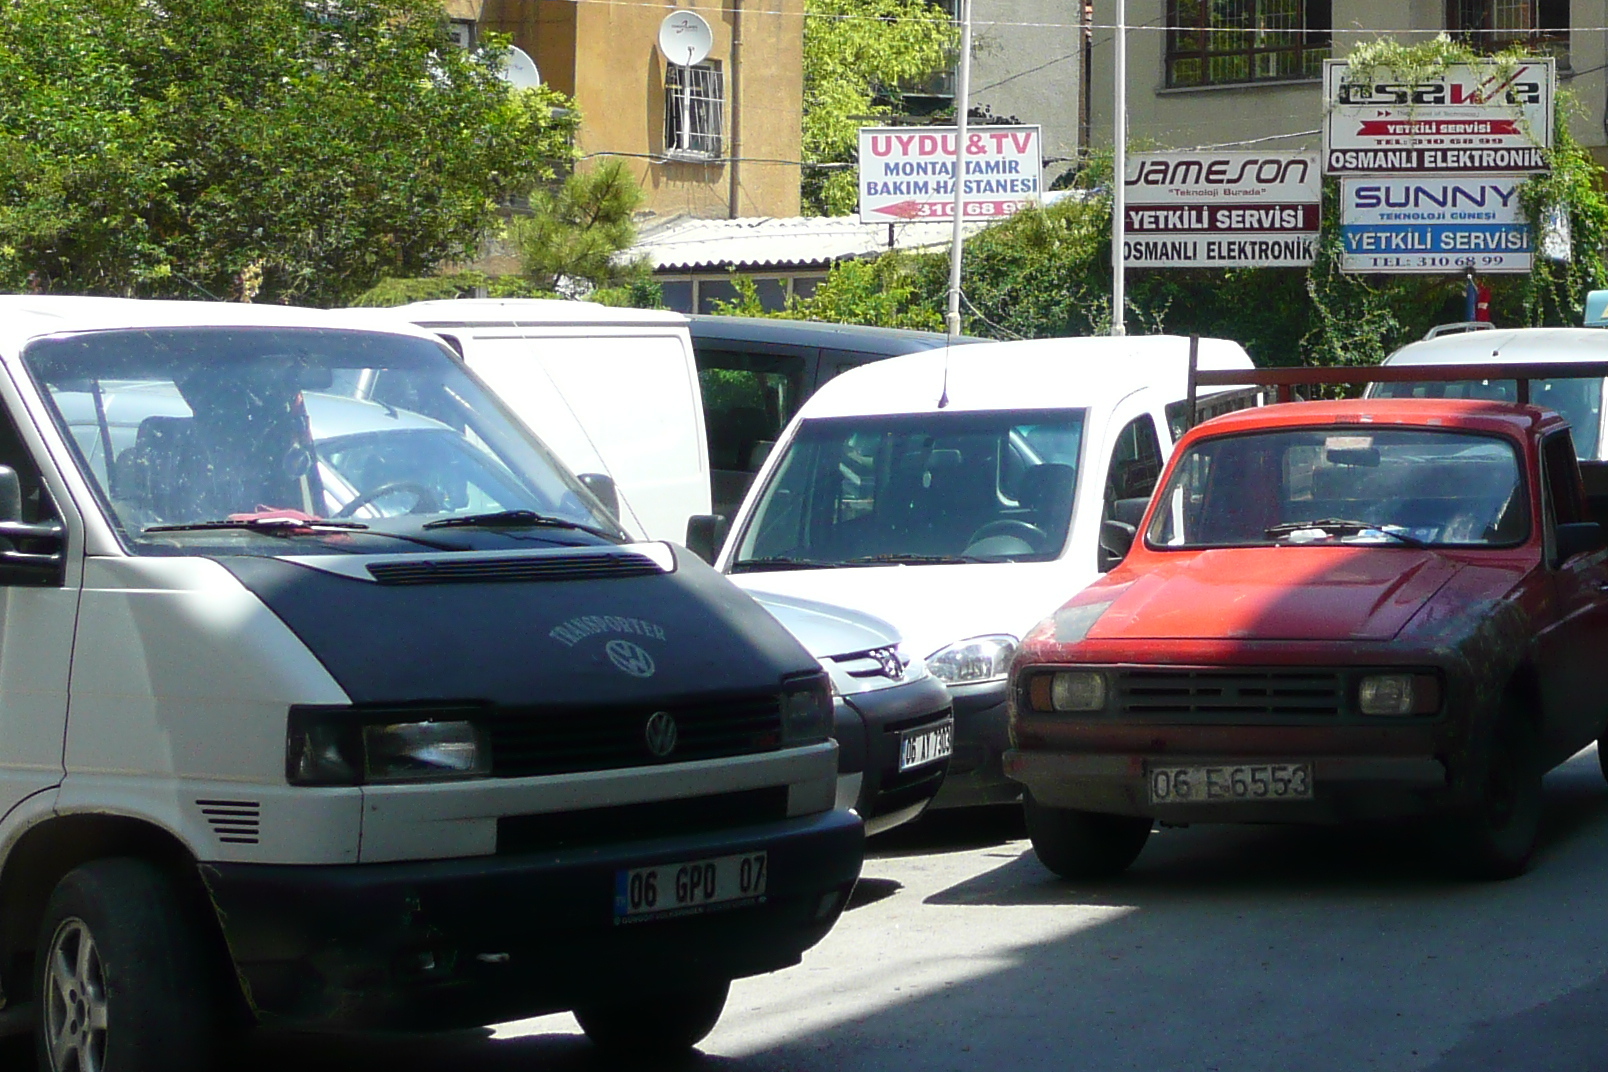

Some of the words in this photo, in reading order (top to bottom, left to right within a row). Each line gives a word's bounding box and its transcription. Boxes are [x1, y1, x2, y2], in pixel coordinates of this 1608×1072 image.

[1387, 122, 1436, 134] YETKİLİ
[1440, 121, 1491, 133] SERVİSİ
[1330, 150, 1417, 168] OSMANLI
[866, 181, 929, 196] BAKIM
[1355, 185, 1517, 208] SUNNY
[967, 202, 994, 215] 68
[1129, 205, 1209, 229] YETKİLİ
[1216, 205, 1304, 229] SERVİSİ
[1124, 240, 1197, 261] OSMANLI
[1206, 236, 1314, 261] ELEKTRONİK
[1347, 227, 1431, 250] YETKİLİ
[1440, 227, 1528, 249] SERVİSİ
[1371, 257, 1411, 267] TEL:
[1416, 257, 1450, 266] 310
[1454, 256, 1476, 266] 68
[1482, 255, 1503, 266] 99
[1153, 769, 1191, 799] 06
[630, 870, 659, 910] 06
[739, 855, 766, 894] 07
